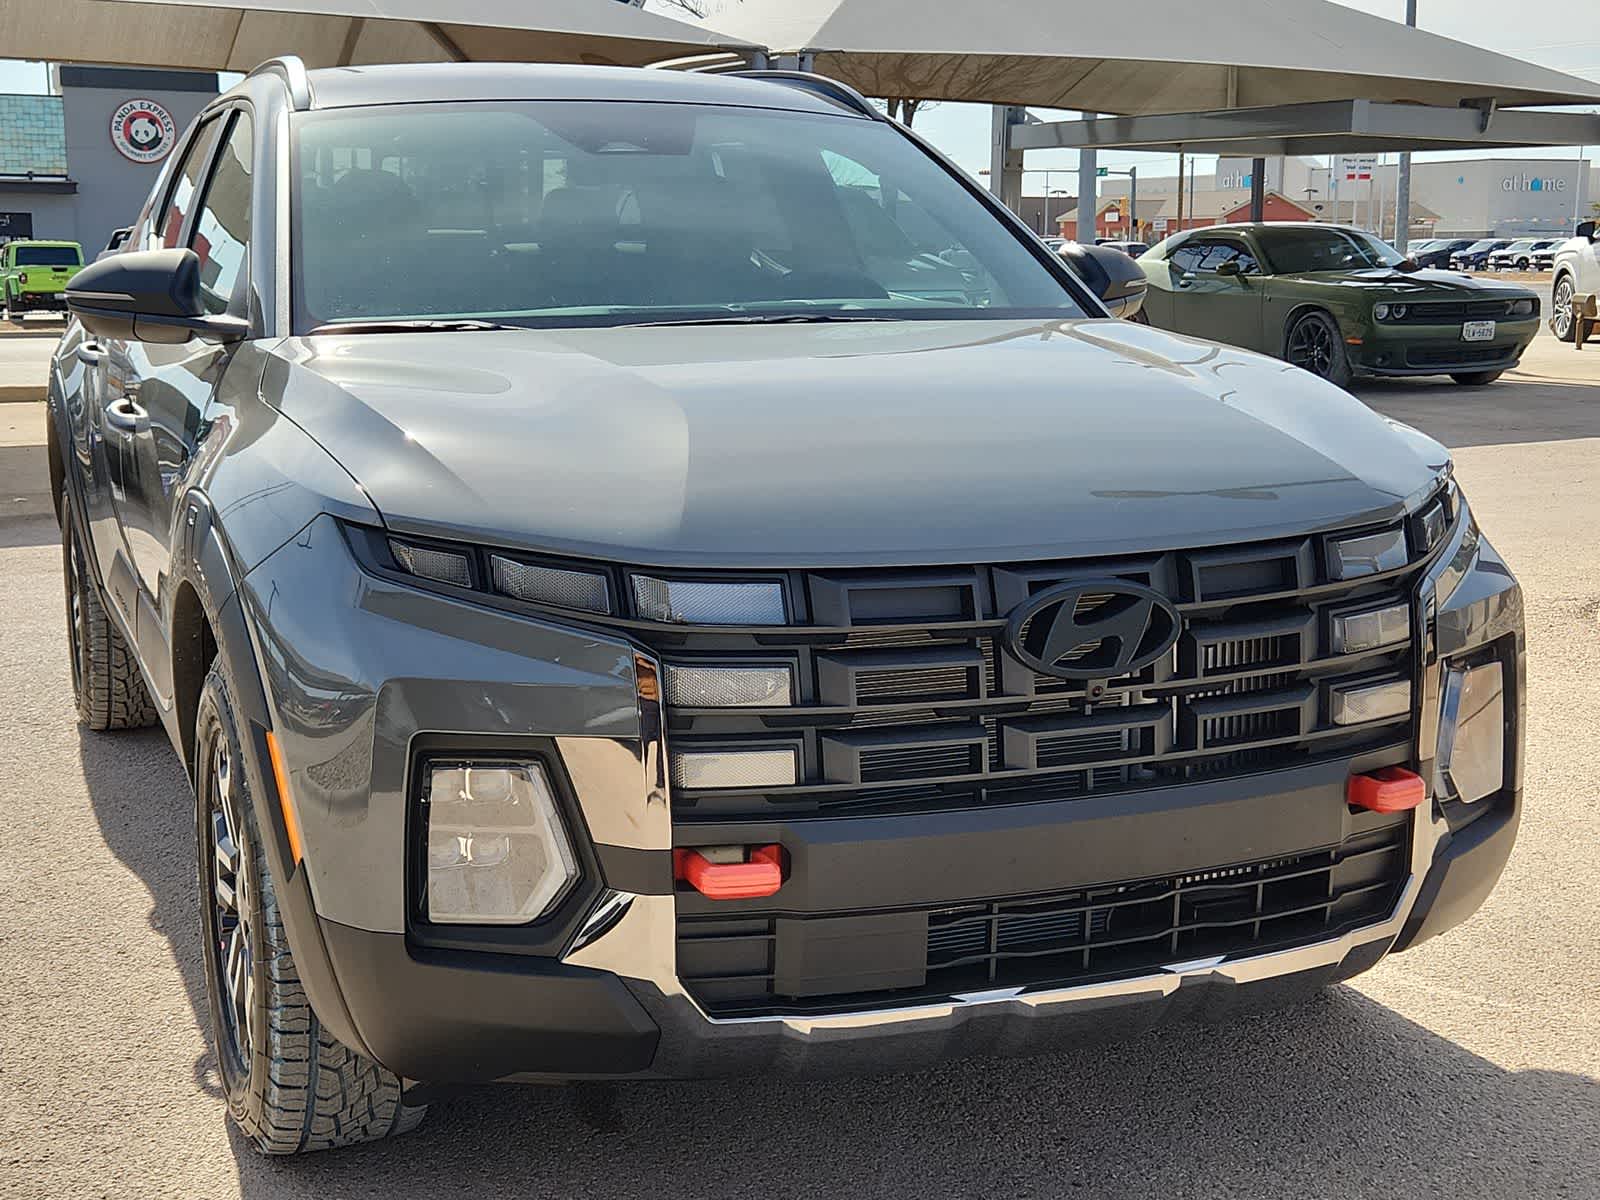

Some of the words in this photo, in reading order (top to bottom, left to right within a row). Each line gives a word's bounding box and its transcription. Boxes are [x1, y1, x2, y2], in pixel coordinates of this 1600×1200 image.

[114, 103, 136, 132] PANDA
[140, 102, 173, 133] EXPRESS
[1502, 175, 1517, 191] at
[1521, 172, 1566, 191] home
